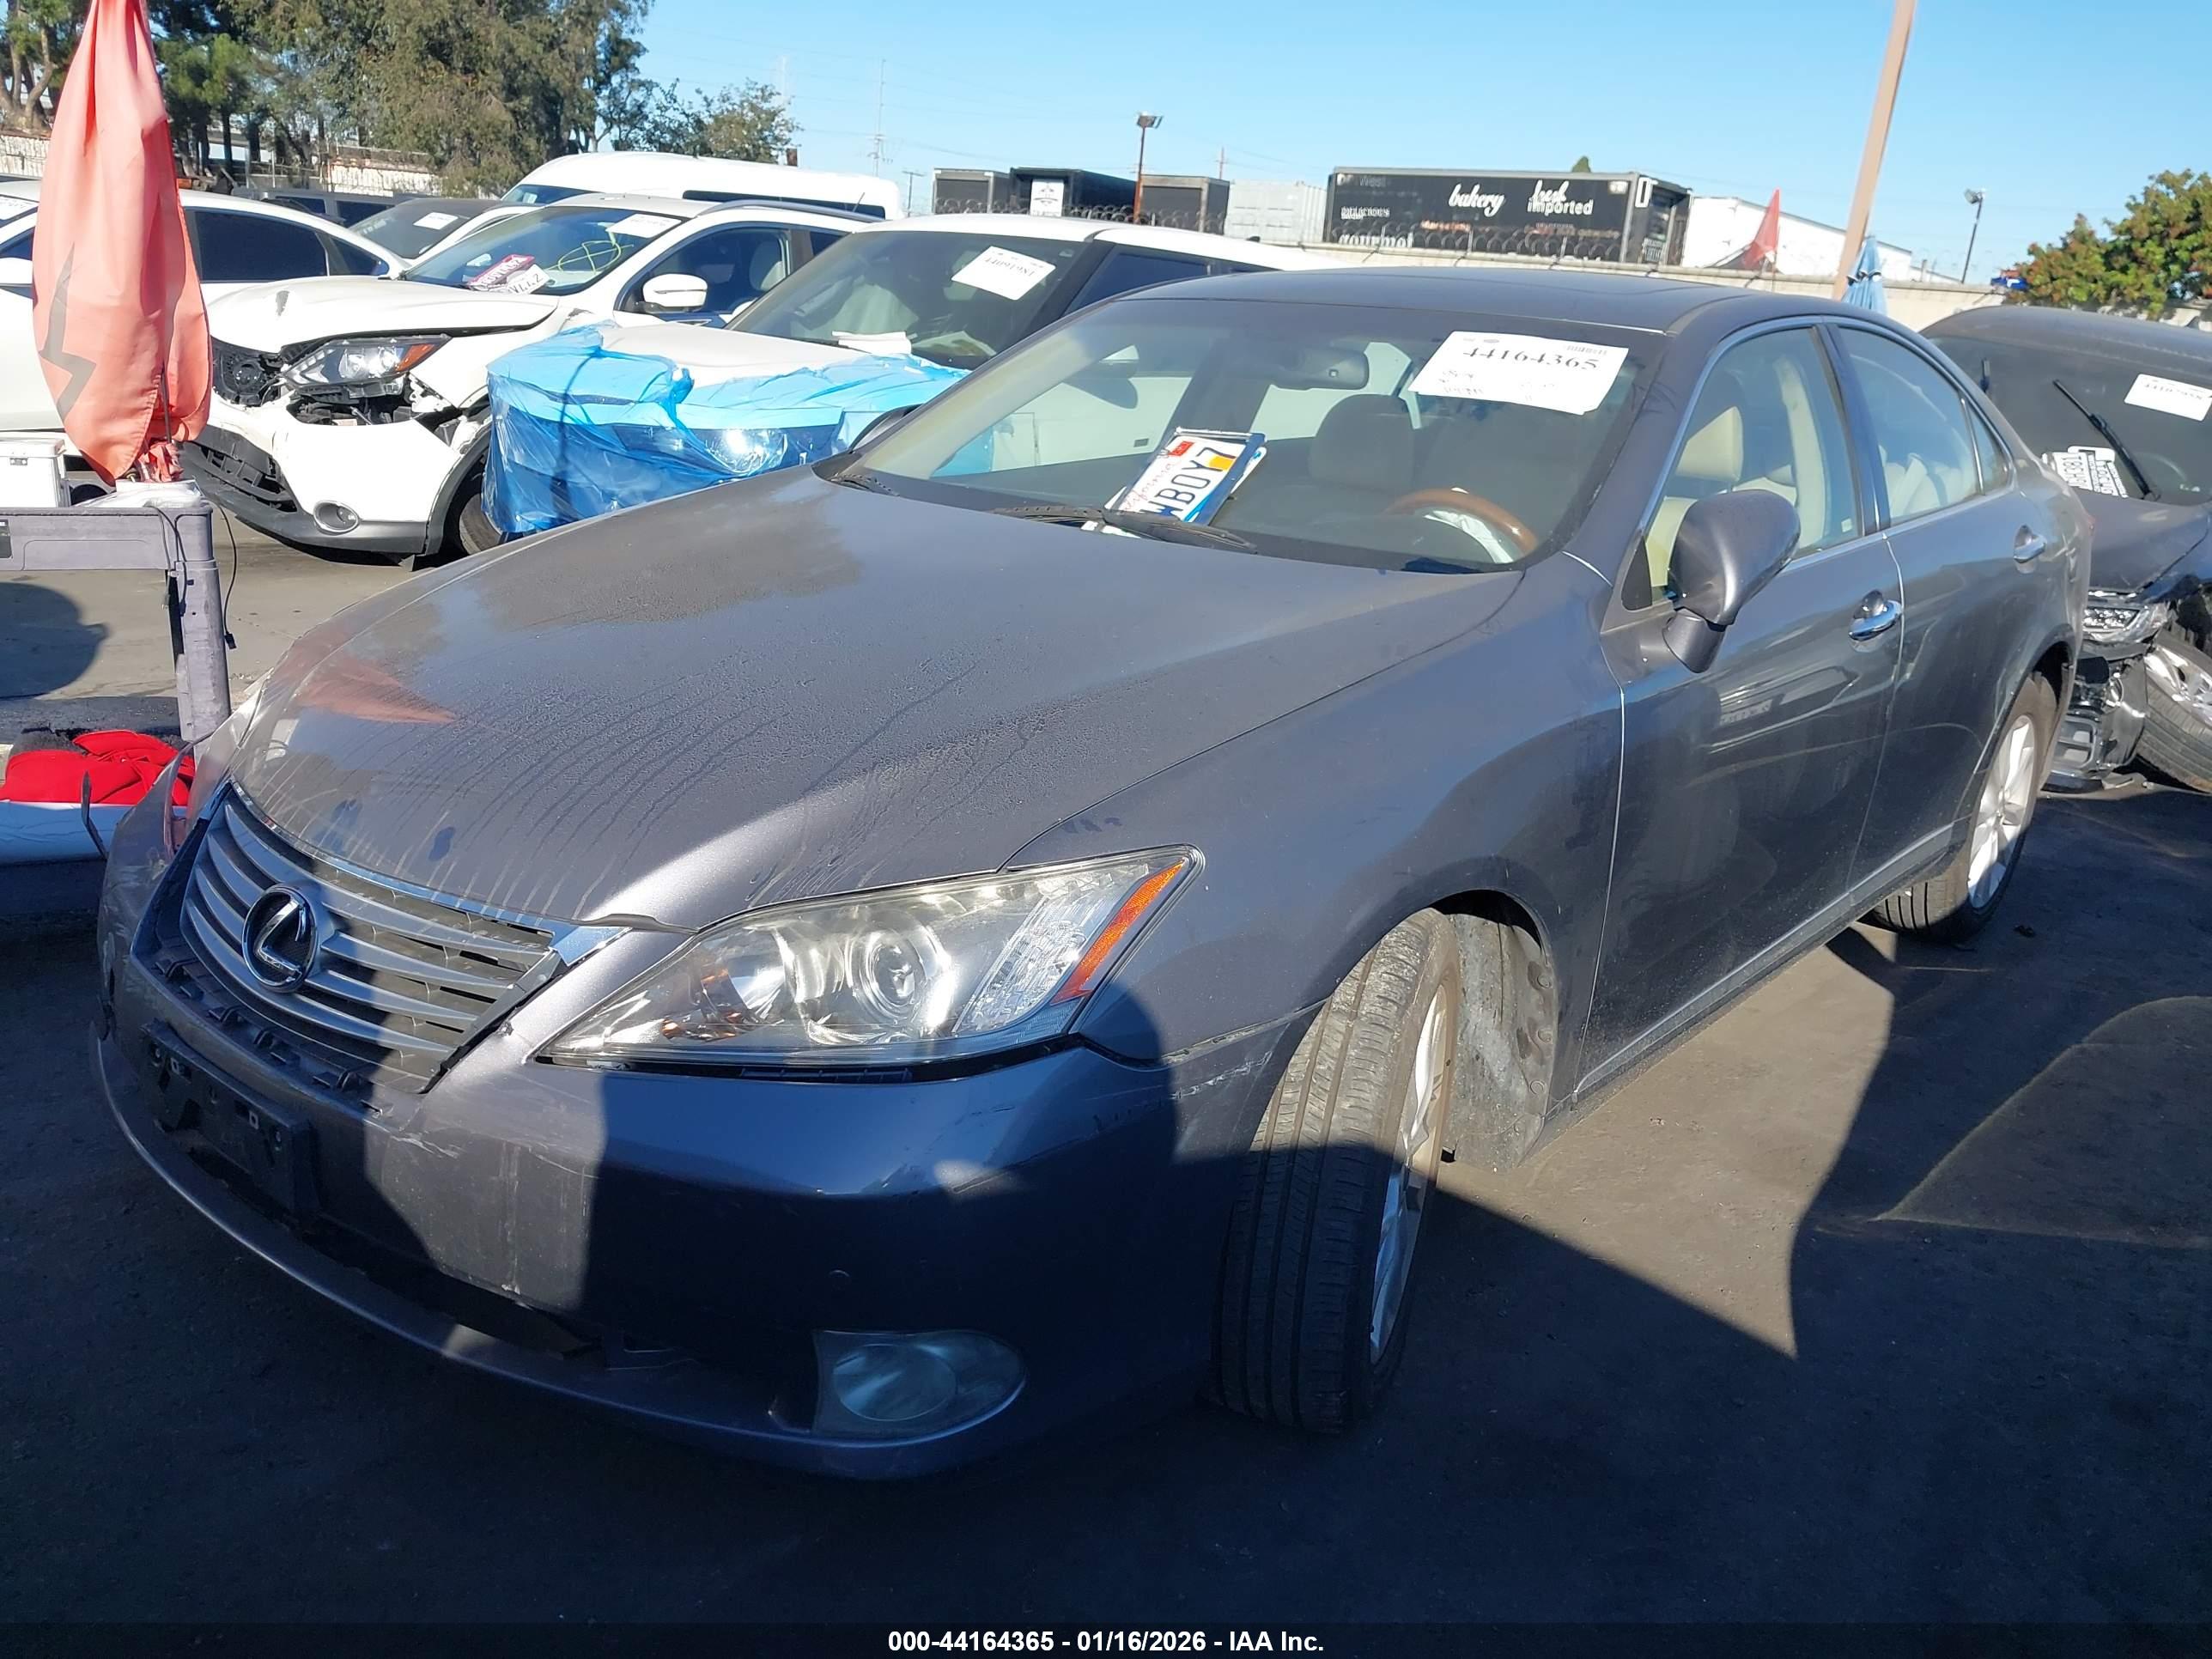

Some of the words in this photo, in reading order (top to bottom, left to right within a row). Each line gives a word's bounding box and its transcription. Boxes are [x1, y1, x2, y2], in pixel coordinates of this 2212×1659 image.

[1449, 175, 1504, 217] bakery
[1527, 198, 1594, 216] imported
[1462, 347, 1600, 370] 44164365
